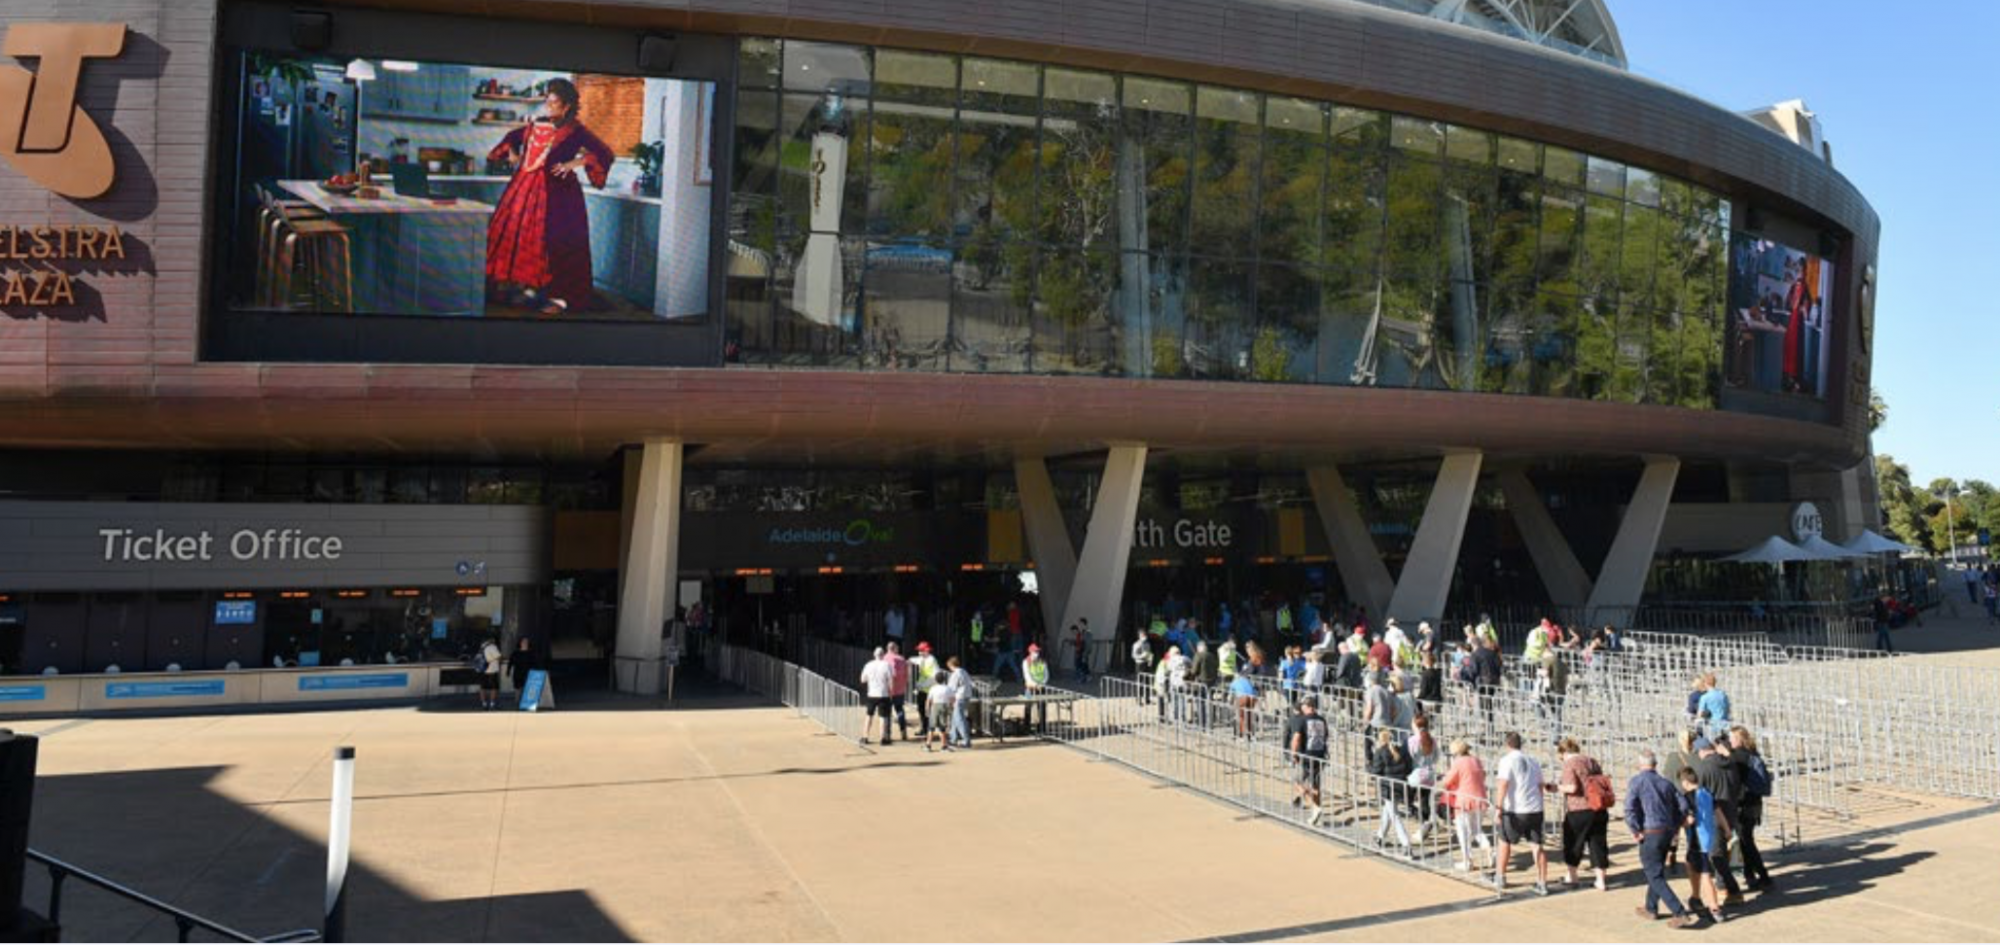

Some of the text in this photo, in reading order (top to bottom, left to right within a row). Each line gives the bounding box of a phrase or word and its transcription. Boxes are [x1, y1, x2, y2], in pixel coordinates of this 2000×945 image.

[0, 271, 74, 305] AZA
[99, 528, 343, 561] Ticket Office
[769, 527, 842, 543] Adelaide
[1132, 518, 1231, 548] th Gate
